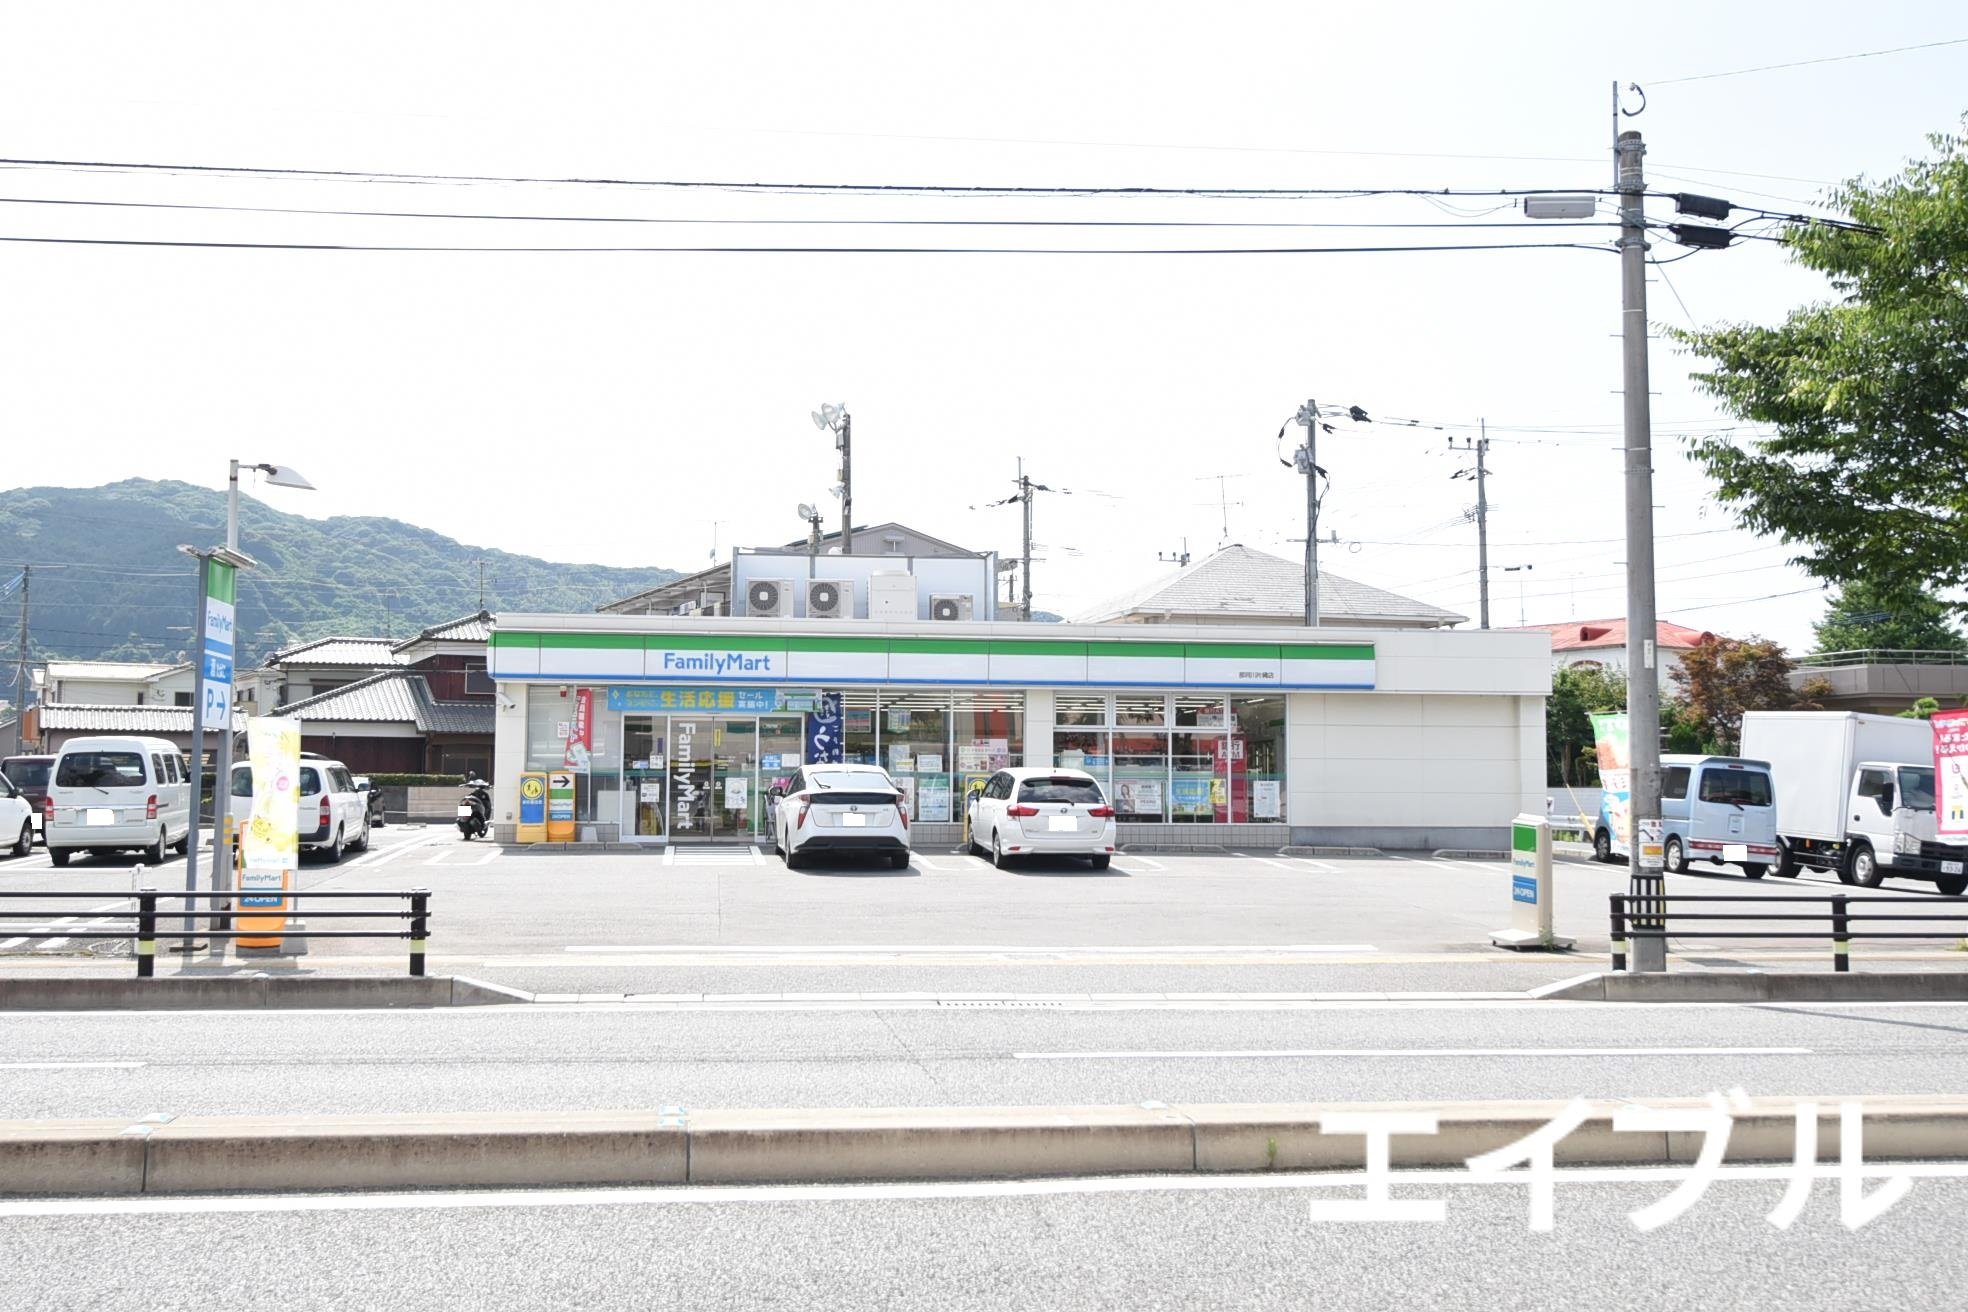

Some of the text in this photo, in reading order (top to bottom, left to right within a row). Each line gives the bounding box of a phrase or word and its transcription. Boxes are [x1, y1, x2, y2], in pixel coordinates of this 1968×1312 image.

[664, 652, 771, 675] FamilyMart
[206, 688, 214, 719] P
[660, 690, 736, 709] 生活応援
[738, 691, 764, 700] セール
[673, 722, 697, 830] FamilyMart
[242, 873, 281, 883] FamilyMart
